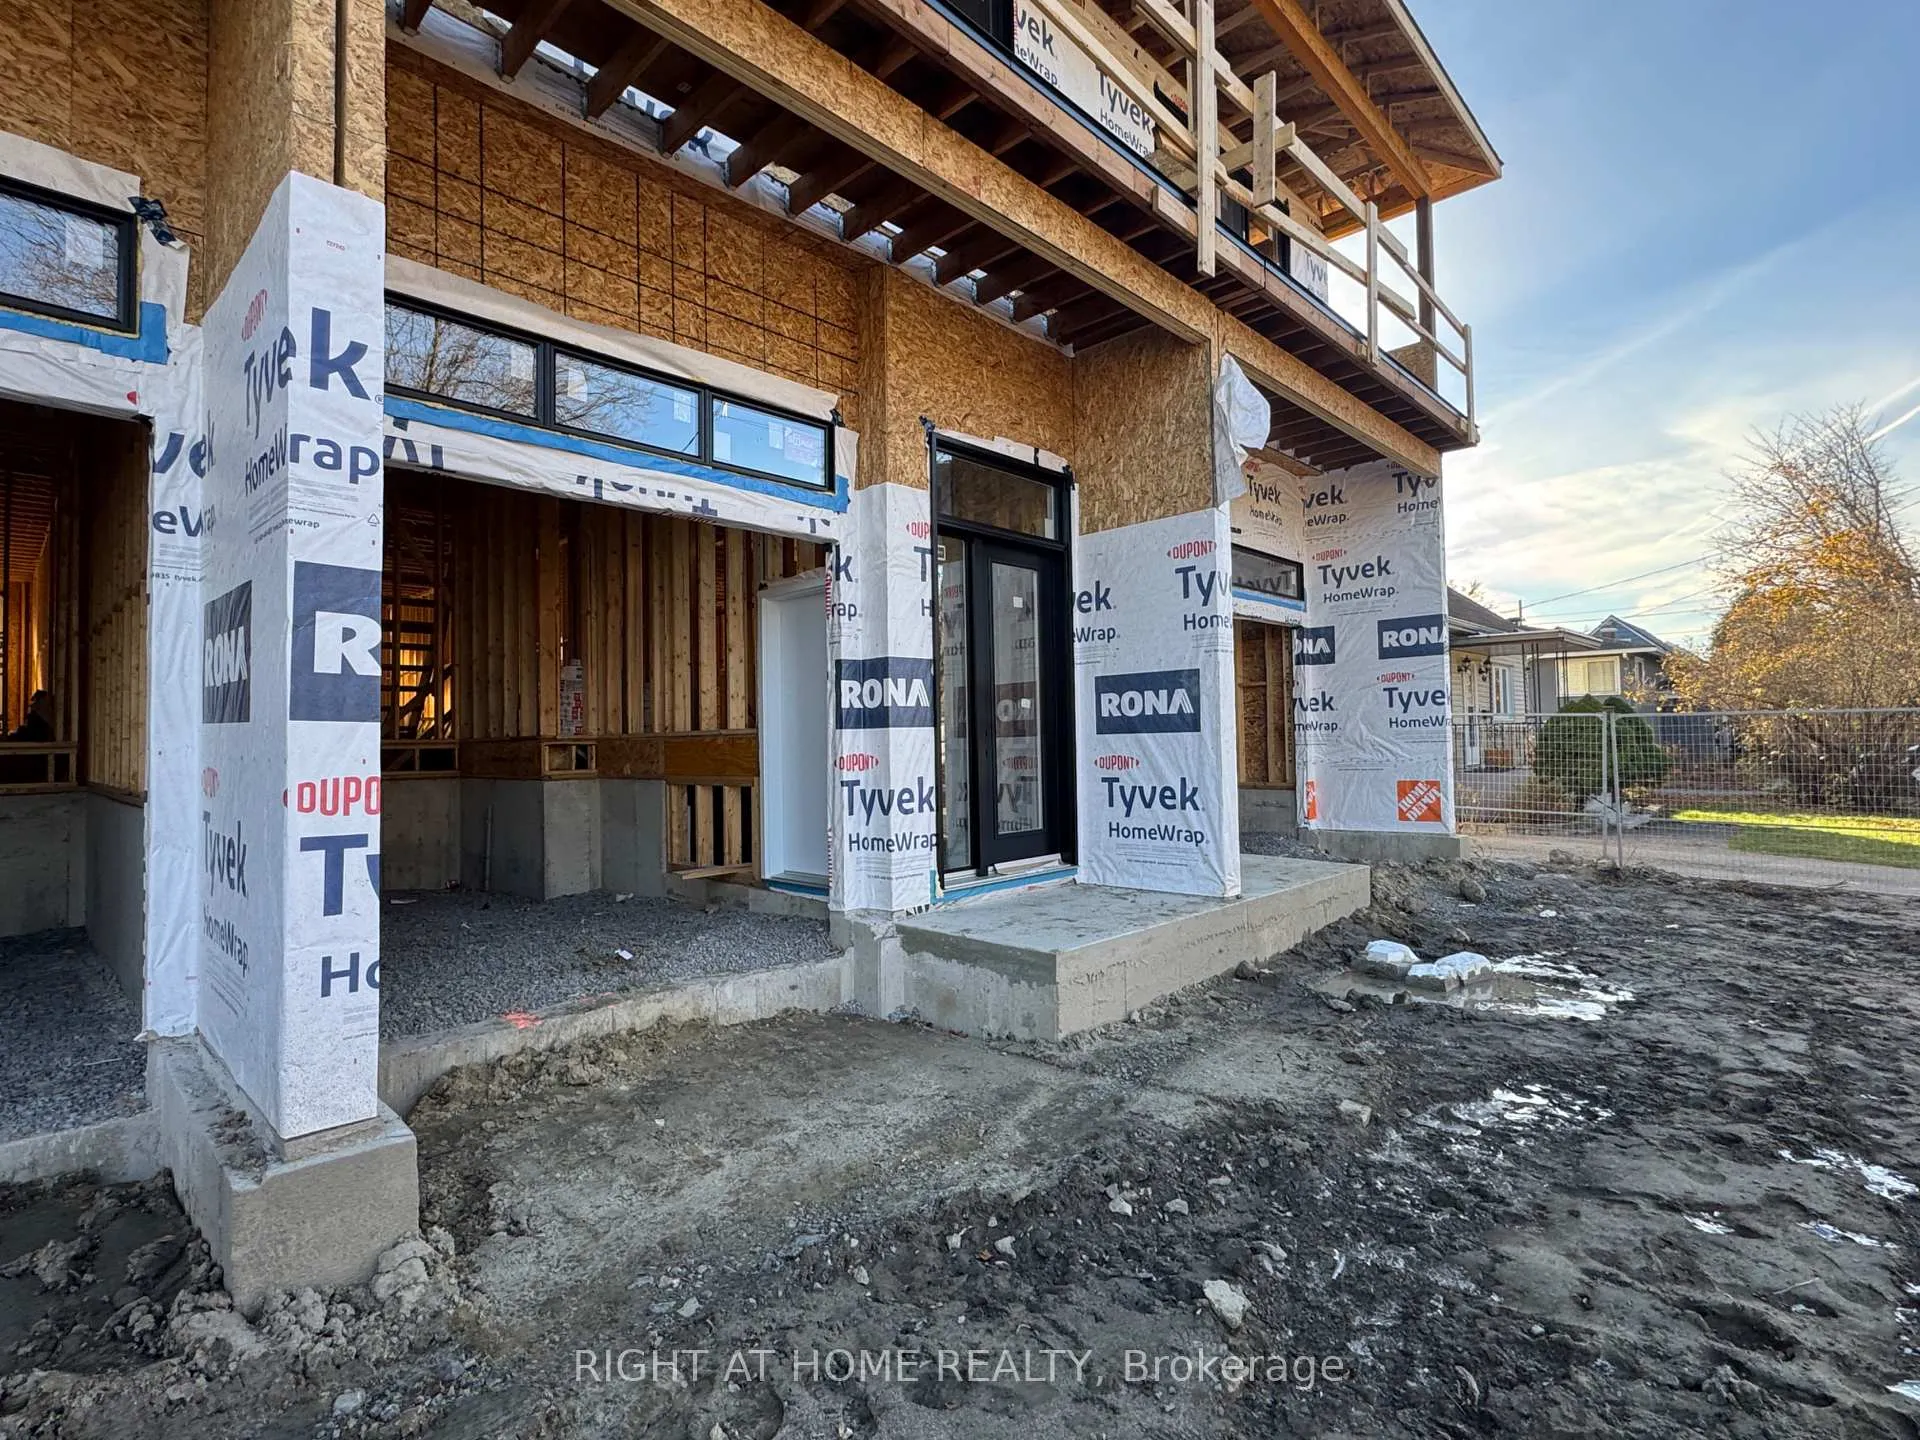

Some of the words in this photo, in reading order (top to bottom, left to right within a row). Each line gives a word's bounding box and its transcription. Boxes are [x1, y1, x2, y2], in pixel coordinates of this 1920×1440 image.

[1246, 473, 1281, 505] Tyvek
[1397, 498, 1440, 514] Home
[1172, 540, 1214, 560] DUPONT
[1315, 548, 1344, 561] DUPONT
[1318, 555, 1392, 589] Tyvek
[1174, 564, 1232, 607] Tyv
[1323, 585, 1396, 604] HomeWrap
[1183, 613, 1233, 631] Home
[204, 626, 248, 688] RONA
[1381, 672, 1412, 683] DUPONT
[840, 678, 930, 709] RONA
[1100, 688, 1194, 718] RONA
[838, 752, 875, 772] DUPONT
[1098, 755, 1136, 770] DUPONT
[840, 776, 936, 826] Tyvek
[1101, 777, 1201, 818] Tyvek
[849, 831, 938, 853] HomeWrap
[1109, 821, 1205, 847] HomeWrap
[203, 810, 247, 898] Tyvek
